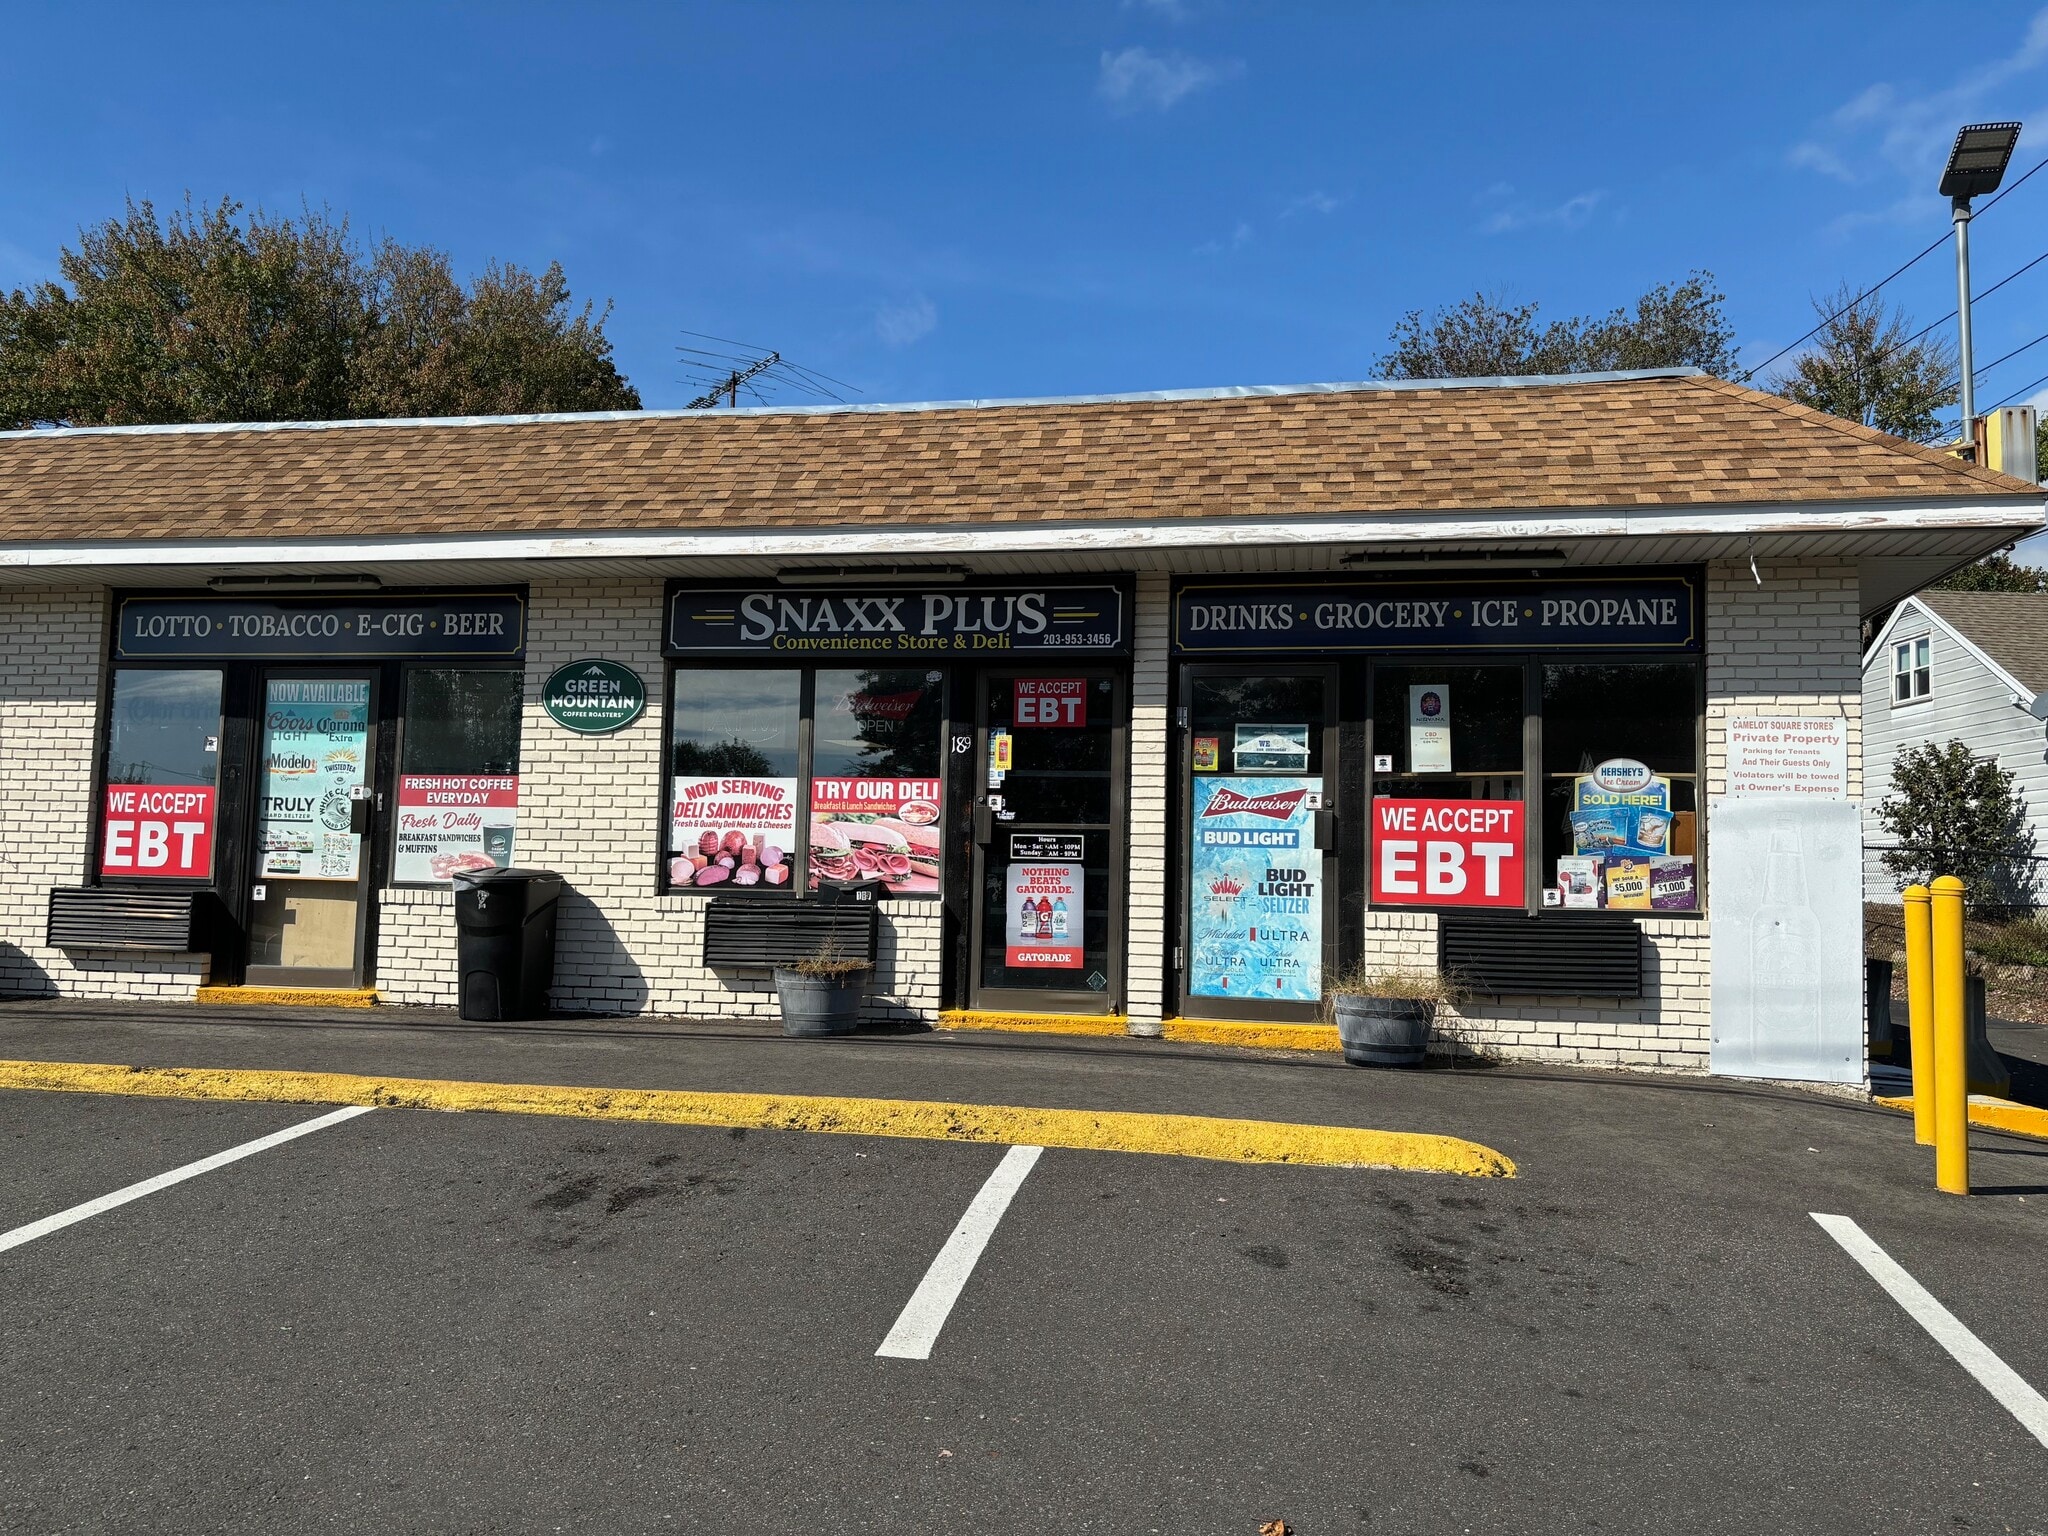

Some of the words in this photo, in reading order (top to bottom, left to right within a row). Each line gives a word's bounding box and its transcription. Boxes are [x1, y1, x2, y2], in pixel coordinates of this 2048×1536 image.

[740, 594, 906, 640] SNAXX
[920, 594, 1047, 634] PLUS
[1190, 604, 1293, 630] DRINKS
[1314, 602, 1450, 629] GROCERY
[1471, 600, 1518, 627] ICE
[1541, 598, 1678, 626] PROPANE
[136, 616, 211, 638] LOTTO
[229, 614, 339, 637] TOBACCO
[356, 614, 424, 636] E-CIG
[443, 613, 504, 636] BEER
[774, 634, 892, 650] Convenience
[898, 634, 948, 650] Store
[954, 634, 968, 649] &
[972, 633, 1010, 649] Deli
[1044, 634, 1111, 645] 203-953-3456
[270, 684, 300, 702] NOW
[302, 684, 366, 702] AVAILABLE
[565, 680, 620, 693] GREEN
[1018, 682, 1036, 693] WE
[1038, 682, 1081, 693] ACCEPT
[551, 694, 634, 709] MOUNTAIN
[1018, 698, 1081, 722] EBT
[267, 712, 314, 730] Coors
[316, 717, 365, 734] Corona
[857, 720, 894, 733] OPEN
[1733, 721, 1769, 729] CAMELOT
[1770, 721, 1801, 730] SQUARE
[1804, 722, 1833, 730] STORES
[272, 732, 308, 740] LIGHT
[329, 732, 353, 742] Extra
[1733, 733, 1779, 742] Private
[1784, 734, 1839, 745] Property
[952, 736, 972, 754] 189
[271, 753, 310, 768] Modelo
[1813, 760, 1830, 768] Only
[1601, 768, 1644, 776] HERSHEY'S
[405, 778, 440, 790] FRESH
[442, 779, 468, 790] HOT
[470, 779, 514, 790] COFFEE
[1616, 777, 1641, 785] Cream
[684, 781, 718, 800] NOW
[722, 780, 786, 801] SERVING
[815, 781, 852, 799] TRY
[856, 782, 894, 800] OUR
[899, 782, 938, 800] DELI
[1794, 785, 1839, 793] Expense
[110, 792, 136, 812] WE
[138, 792, 206, 814] ACCEPT
[262, 797, 315, 812] TRULY
[320, 790, 334, 815] WHITE
[335, 788, 350, 799] CLA
[426, 792, 489, 804] EVERYDAY
[1208, 793, 1298, 811] Budweiser
[1583, 795, 1620, 805] SOLD
[1622, 795, 1662, 805] HERE!
[674, 802, 705, 818] DELI
[706, 802, 794, 820] SANDWICHES
[814, 801, 841, 810] Breakfast
[842, 802, 846, 810] &
[847, 802, 863, 810] Lunch
[864, 802, 896, 811] Sandwiches
[400, 814, 438, 830] Fresh
[442, 812, 482, 830] Daily
[700, 820, 723, 829] Quality
[764, 821, 792, 829] Cheeses
[1381, 807, 1416, 831] WE
[1421, 808, 1513, 833] ACCEPT
[104, 820, 205, 868] EBT
[398, 833, 437, 842] BREAKFAST
[438, 834, 481, 842] SANDWICHES
[1204, 831, 1241, 844] BUD
[1244, 832, 1296, 845] LIGHT
[398, 844, 405, 853] &
[405, 844, 438, 853] MUFFINS
[1022, 868, 1069, 876] NOTHING
[1381, 840, 1514, 896] EBT
[1266, 869, 1306, 882] BUD
[1258, 883, 1313, 896] LIGHT
[1615, 882, 1642, 891] $5,000
[1658, 881, 1685, 892] $1,000
[1264, 897, 1309, 914] SELTZER
[1198, 928, 1246, 940] Michelob
[1260, 930, 1309, 941] ULTRA
[1018, 953, 1071, 962] GATORADE
[1206, 957, 1246, 966] ULTRA
[1260, 959, 1300, 968] ULTRA
